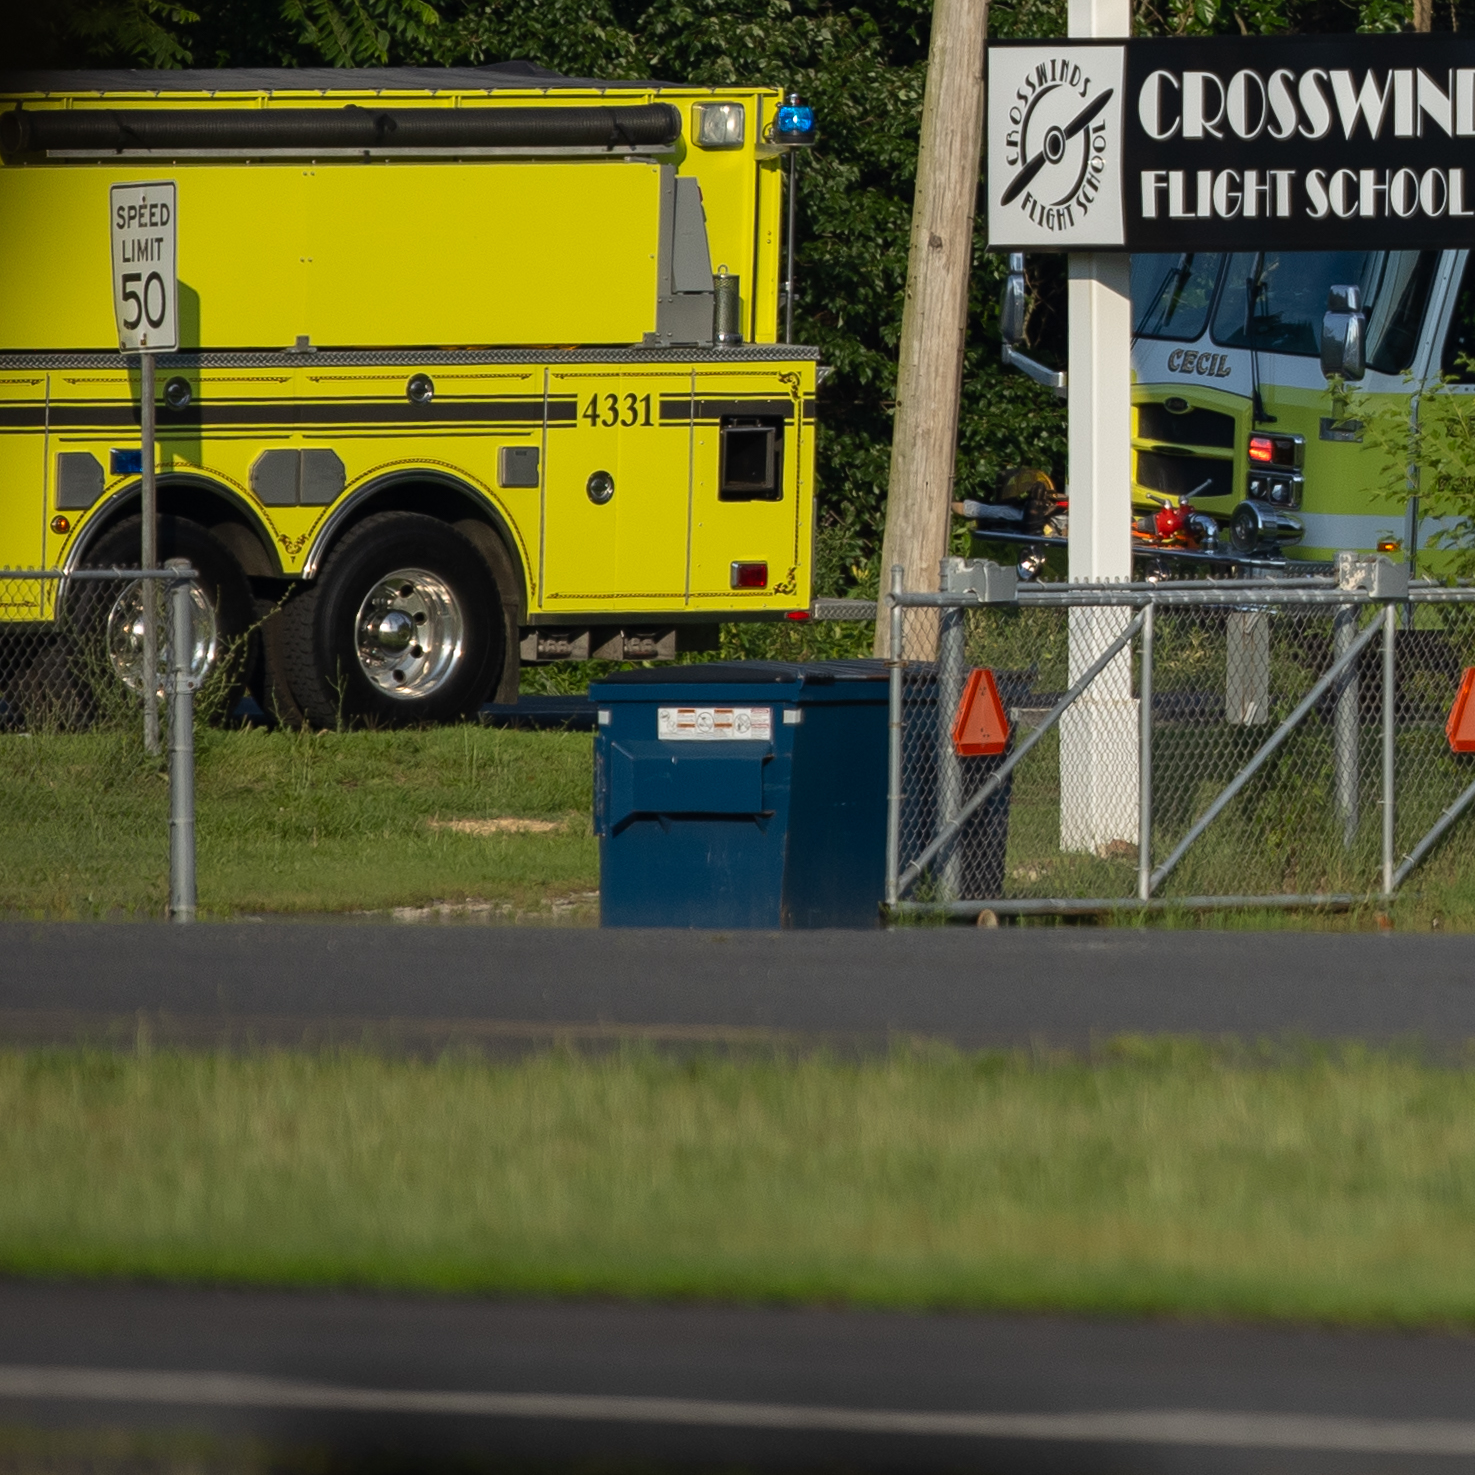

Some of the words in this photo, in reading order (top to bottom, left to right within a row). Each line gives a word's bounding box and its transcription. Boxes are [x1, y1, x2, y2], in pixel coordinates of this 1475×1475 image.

[1006, 58, 1092, 166] CROSSWINDS
[1020, 191, 1075, 233] FLIGHT
[1076, 119, 1107, 217] SCHOOL
[1140, 168, 1296, 219] FLIGHT
[1305, 167, 1475, 219] SCHOOL
[116, 203, 170, 229] SPEED
[122, 237, 164, 263] LIMIT
[121, 271, 166, 331] 50
[1167, 348, 1232, 378] CECIL
[582, 392, 654, 427] 4331
